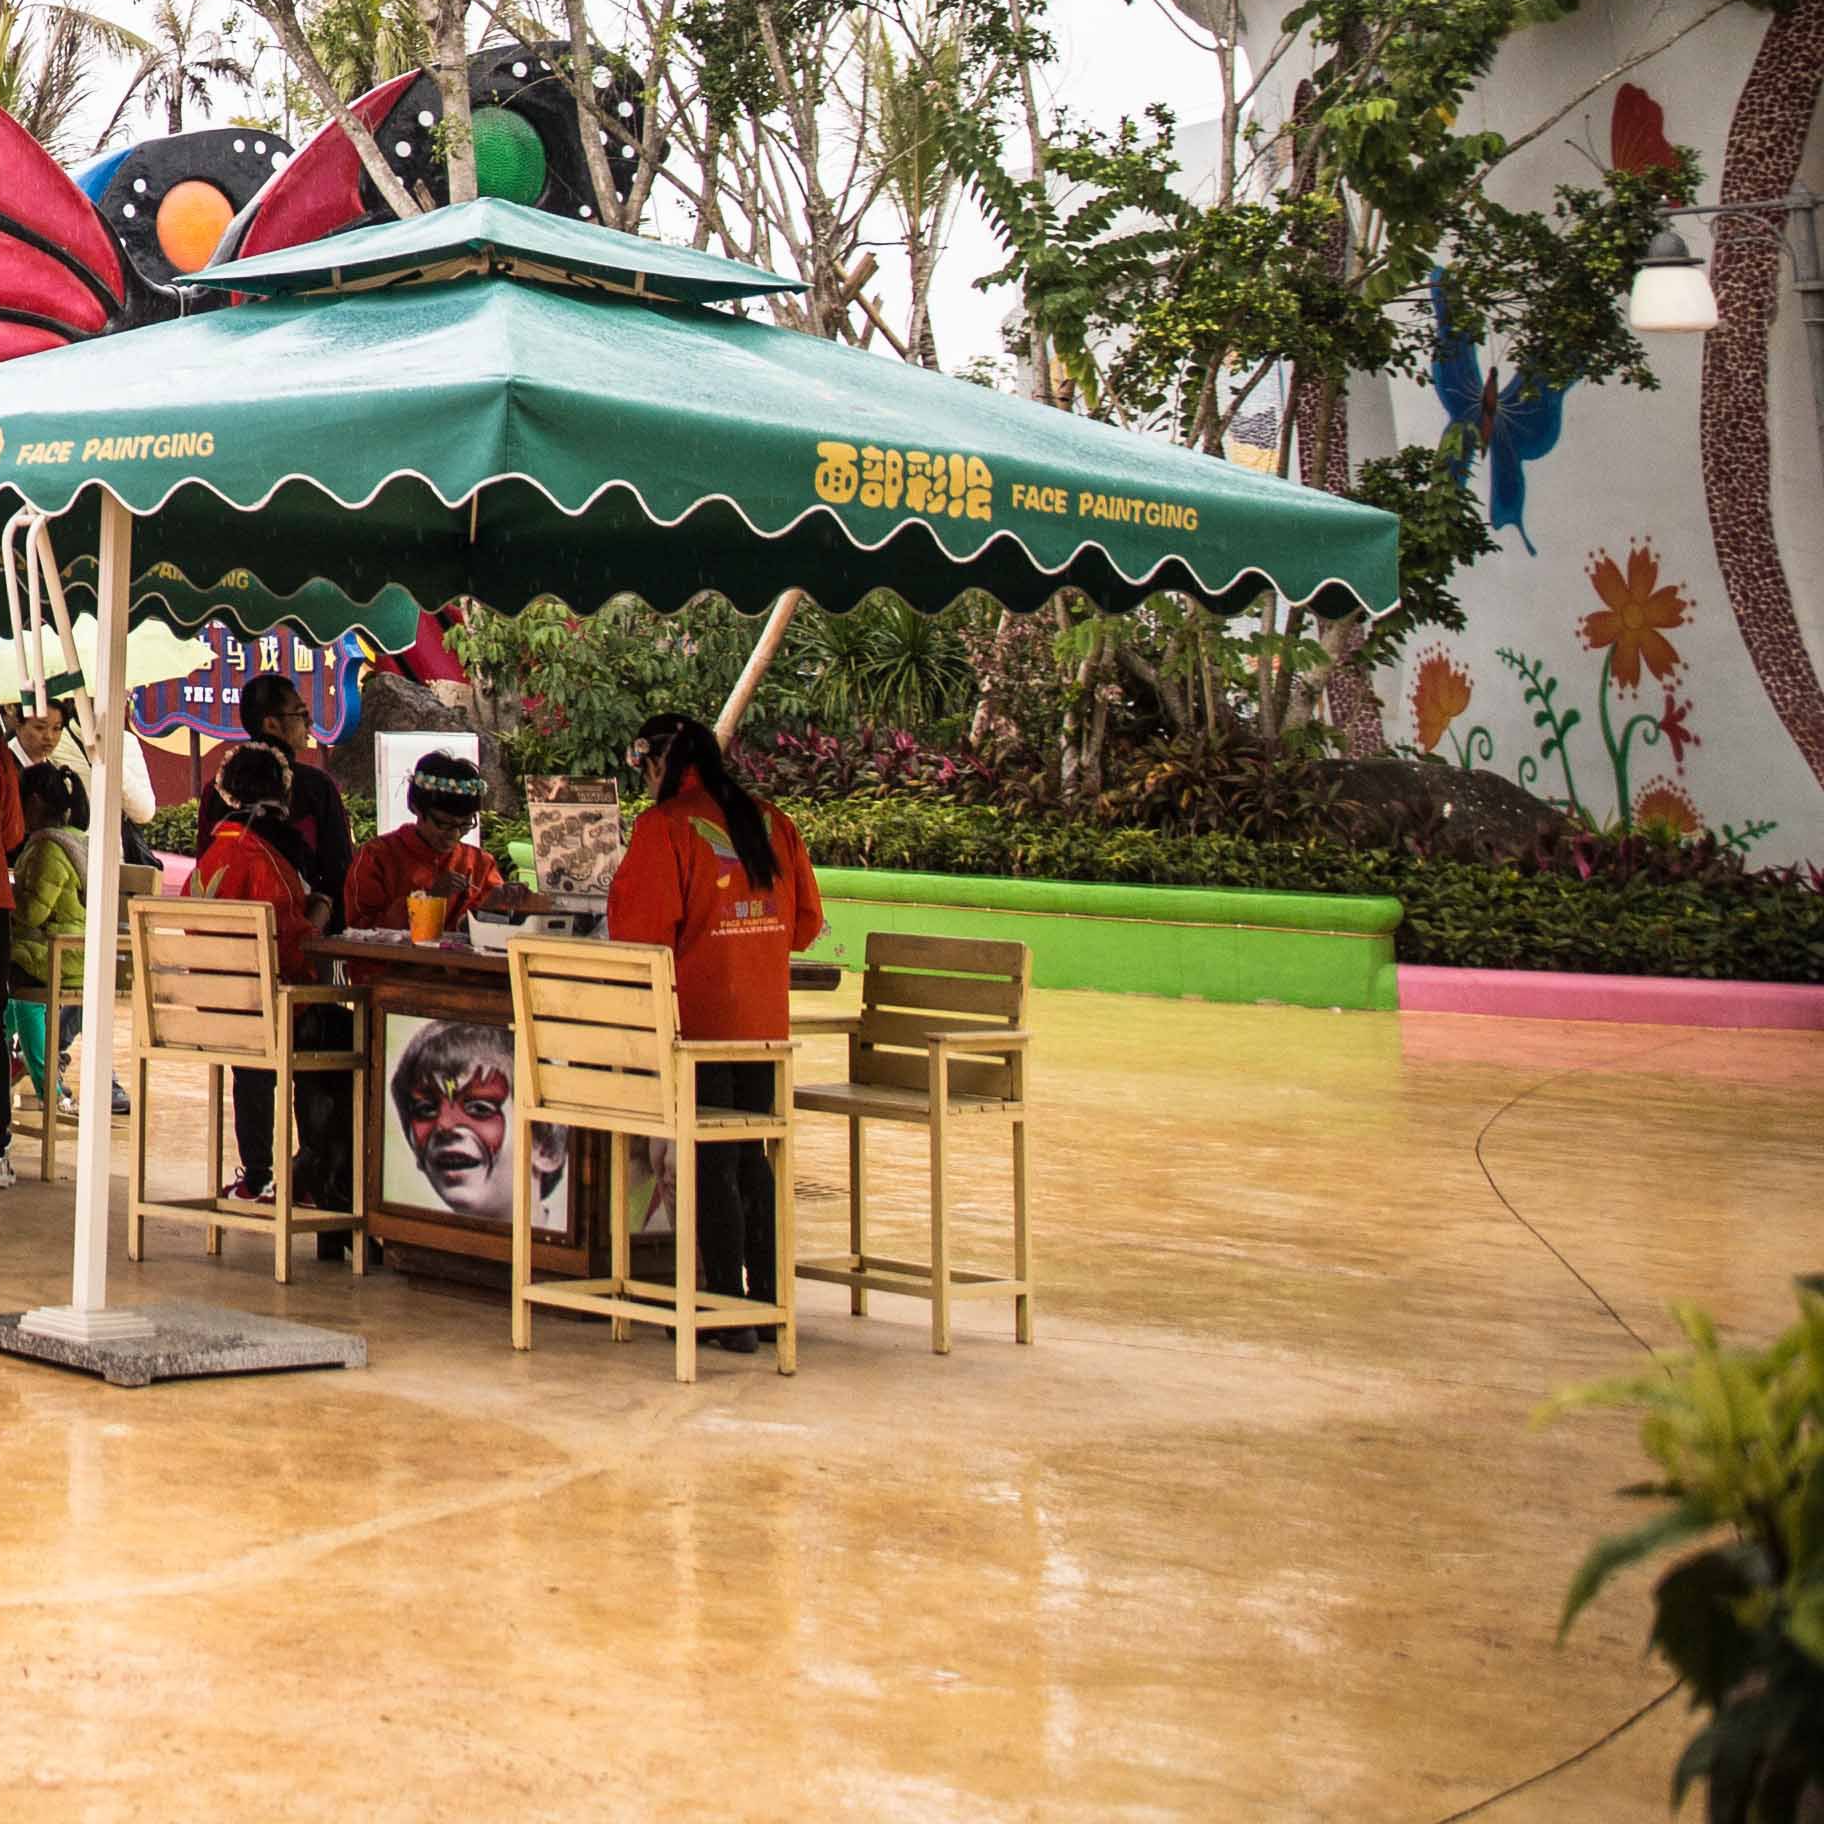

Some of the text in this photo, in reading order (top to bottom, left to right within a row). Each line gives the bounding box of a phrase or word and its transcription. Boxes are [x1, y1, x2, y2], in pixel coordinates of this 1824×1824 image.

[16, 432, 214, 465] FACE PAINTGING
[815, 441, 993, 522] 面部彩绘
[1011, 484, 1200, 531] FACE PAINTGING
[184, 686, 214, 703] THE
